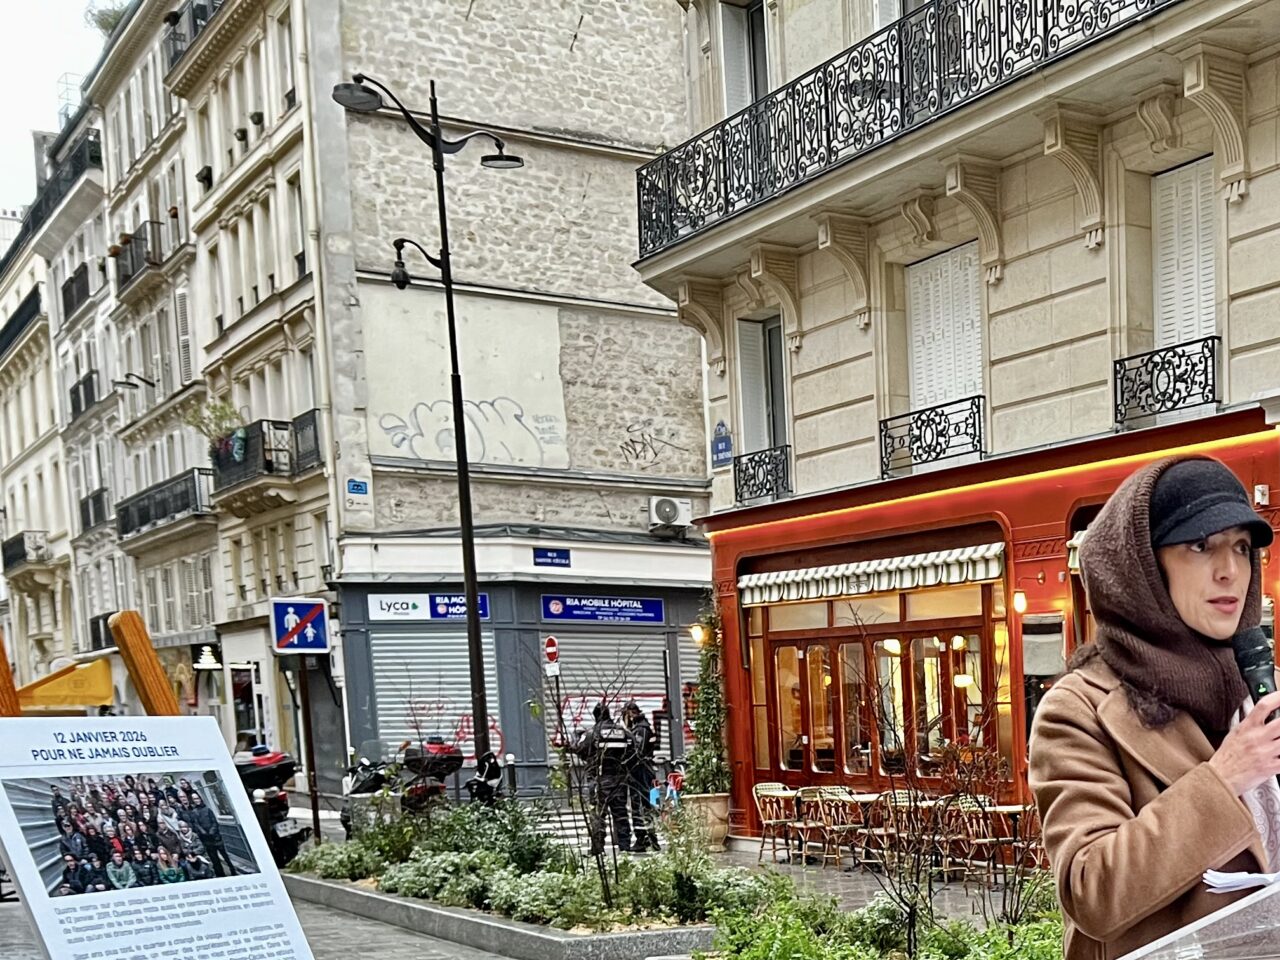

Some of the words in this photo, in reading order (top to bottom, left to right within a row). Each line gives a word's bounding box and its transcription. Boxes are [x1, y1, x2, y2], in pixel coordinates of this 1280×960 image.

[380, 600, 409, 612] Lyca
[566, 598, 580, 606] RIA
[580, 598, 609, 607] MOBILE
[611, 598, 643, 608] HÔPITAL
[53, 732, 67, 743] 12
[69, 731, 119, 743] JANVIER
[119, 731, 147, 742] 2026
[31, 749, 67, 761] POUR
[67, 748, 85, 760] NE
[87, 747, 131, 759] JAMAIS
[131, 746, 180, 757] OUBLIER
